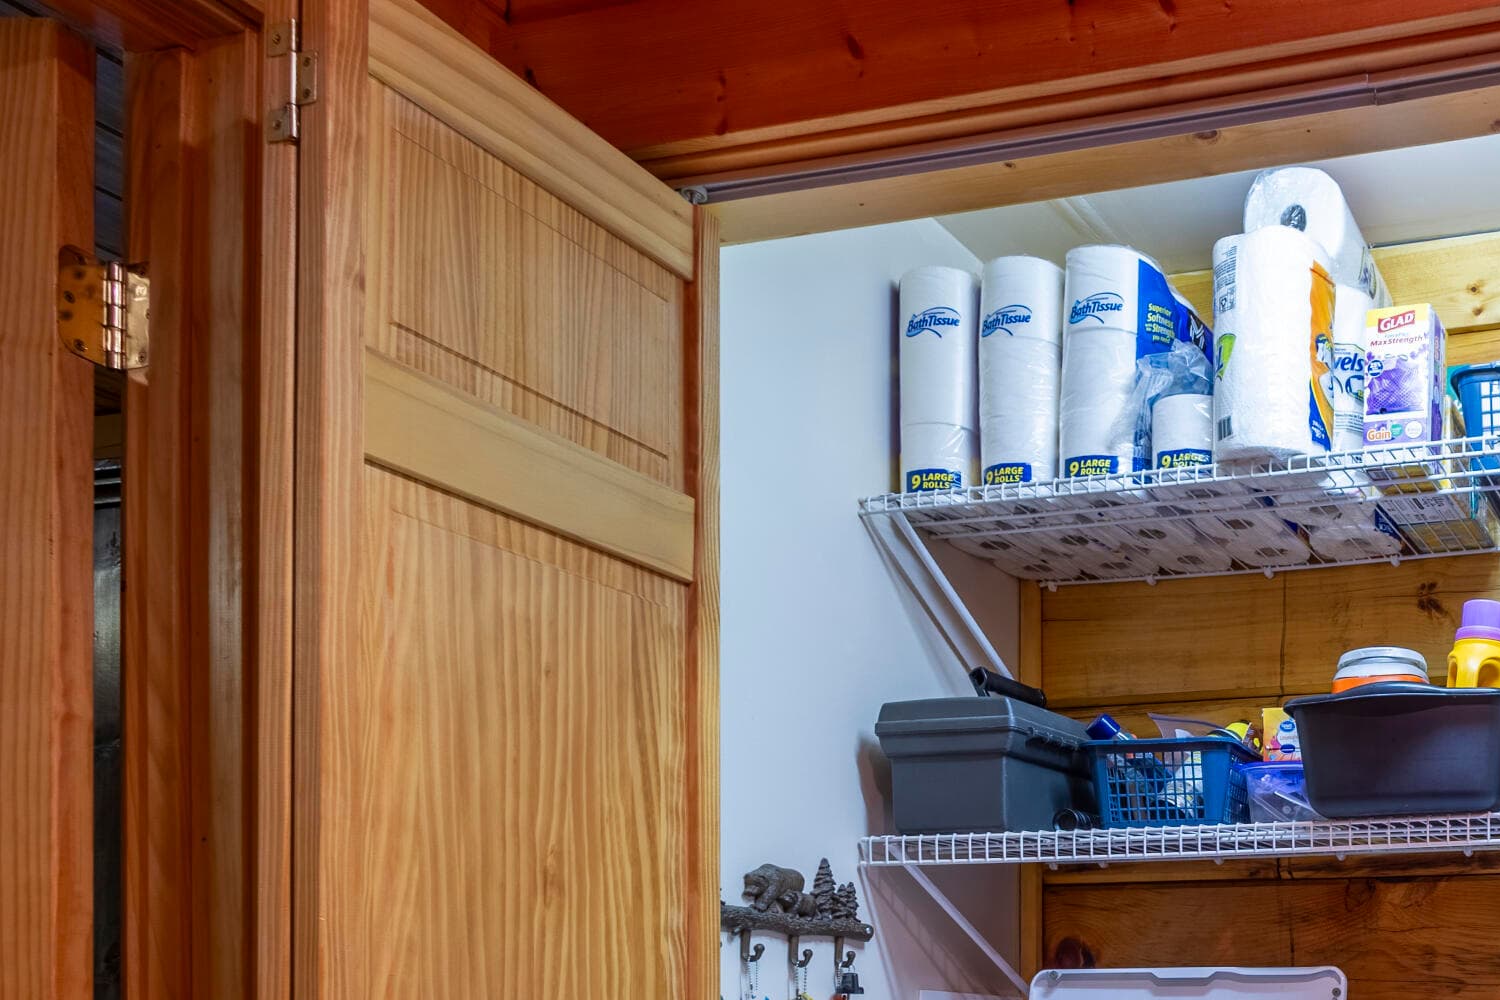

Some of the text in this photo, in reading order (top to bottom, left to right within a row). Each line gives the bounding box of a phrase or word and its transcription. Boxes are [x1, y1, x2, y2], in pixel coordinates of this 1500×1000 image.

[1379, 312, 1415, 331] GLAD
[1367, 426, 1391, 440] Gain
[1069, 459, 1111, 476] 9 LARGE
[1161, 455, 1171, 468] 9
[986, 466, 1024, 485] 9 LARGE
[1080, 467, 1109, 476] ROLLS
[911, 472, 954, 490] 9 LARGE
[922, 481, 950, 489] ROLLS
[995, 475, 1021, 484] ROLLS
